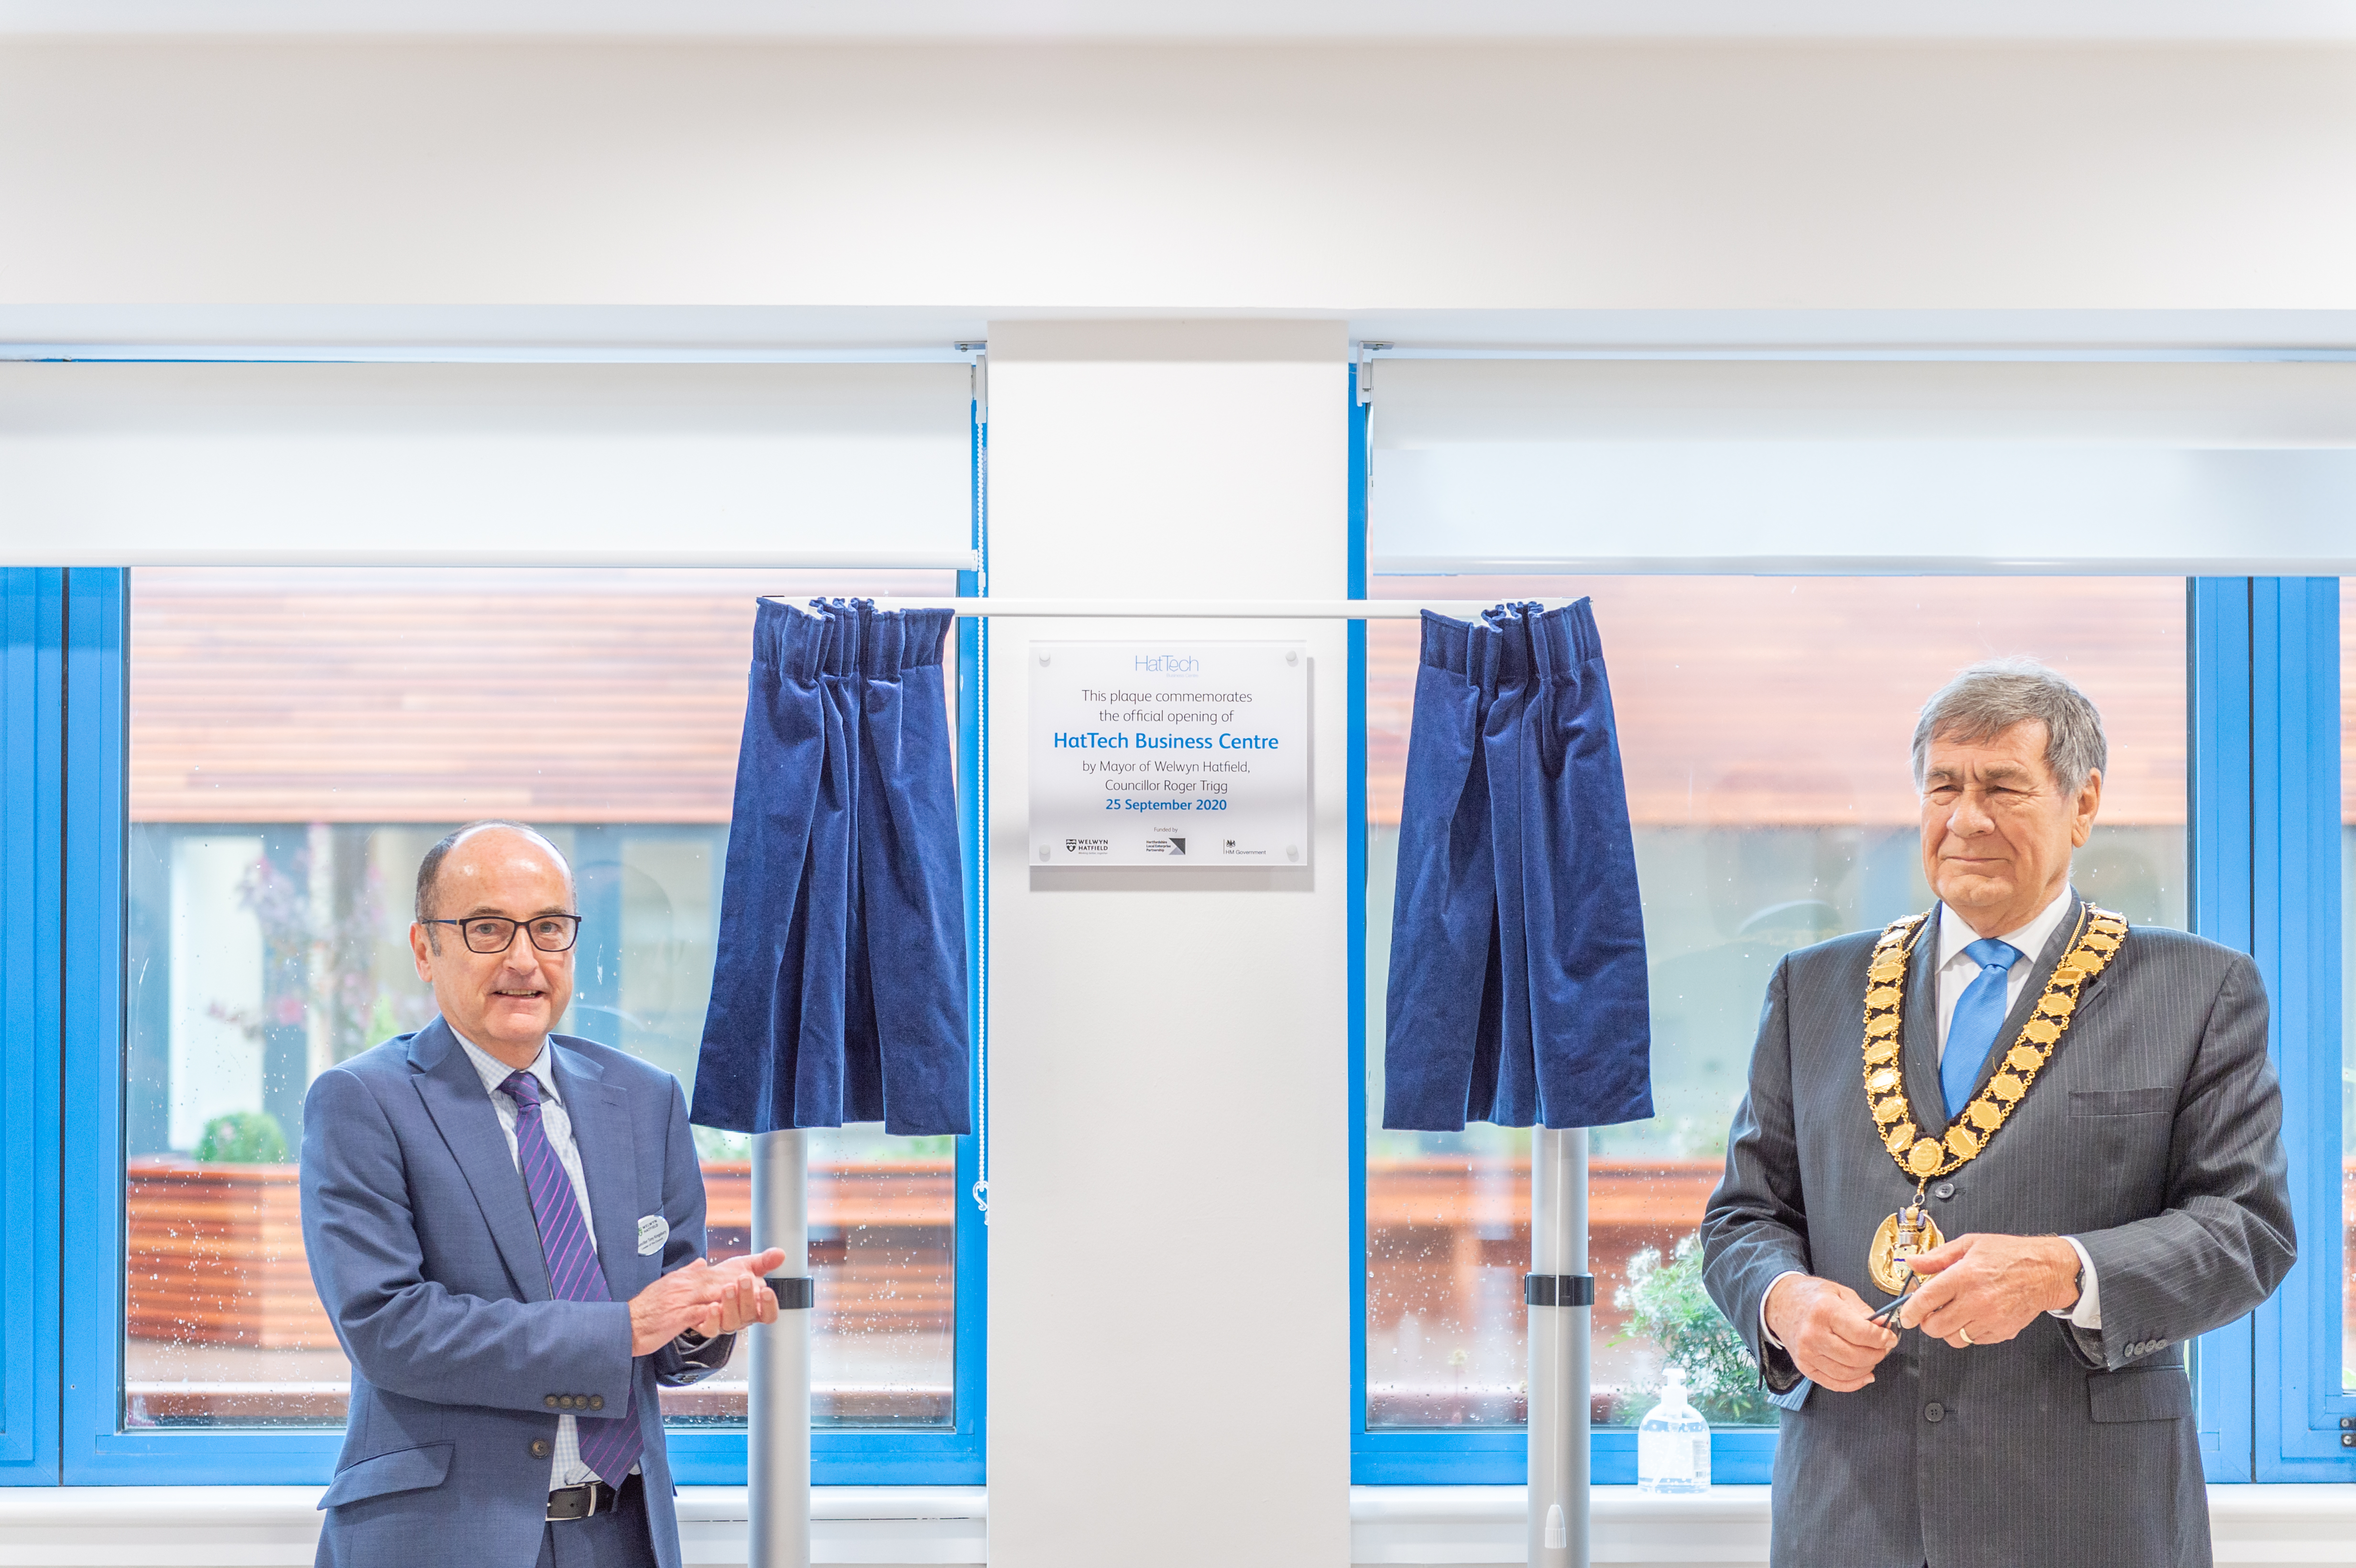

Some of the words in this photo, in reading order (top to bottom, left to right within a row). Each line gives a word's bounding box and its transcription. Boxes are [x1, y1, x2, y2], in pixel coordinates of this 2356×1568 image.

[1135, 655, 1199, 672] HatTech
[1081, 689, 1106, 702] This
[1110, 689, 1152, 705] plaque
[1156, 691, 1253, 702] commemorates
[1099, 709, 1119, 722] the
[1123, 709, 1163, 722] official
[1167, 711, 1217, 725] opening
[1221, 710, 1234, 722] of
[1054, 732, 1129, 749] HatTech
[1135, 732, 1213, 749] Business
[1219, 733, 1279, 750] Centre
[1083, 760, 1096, 774] by
[1100, 761, 1136, 775] Mayor
[1139, 760, 1152, 772] of
[1154, 761, 1199, 775] Welwyn
[1203, 761, 1250, 773] Hatfield,
[1105, 779, 1160, 791] Councillor
[1164, 780, 1197, 794] Roger
[1200, 780, 1228, 795] Trigg
[1105, 798, 1121, 810] 25
[1125, 798, 1192, 813] September
[1196, 799, 1227, 811] 2020
[642, 1220, 657, 1229] WELWYN
[644, 1223, 658, 1233] HATFIELD
